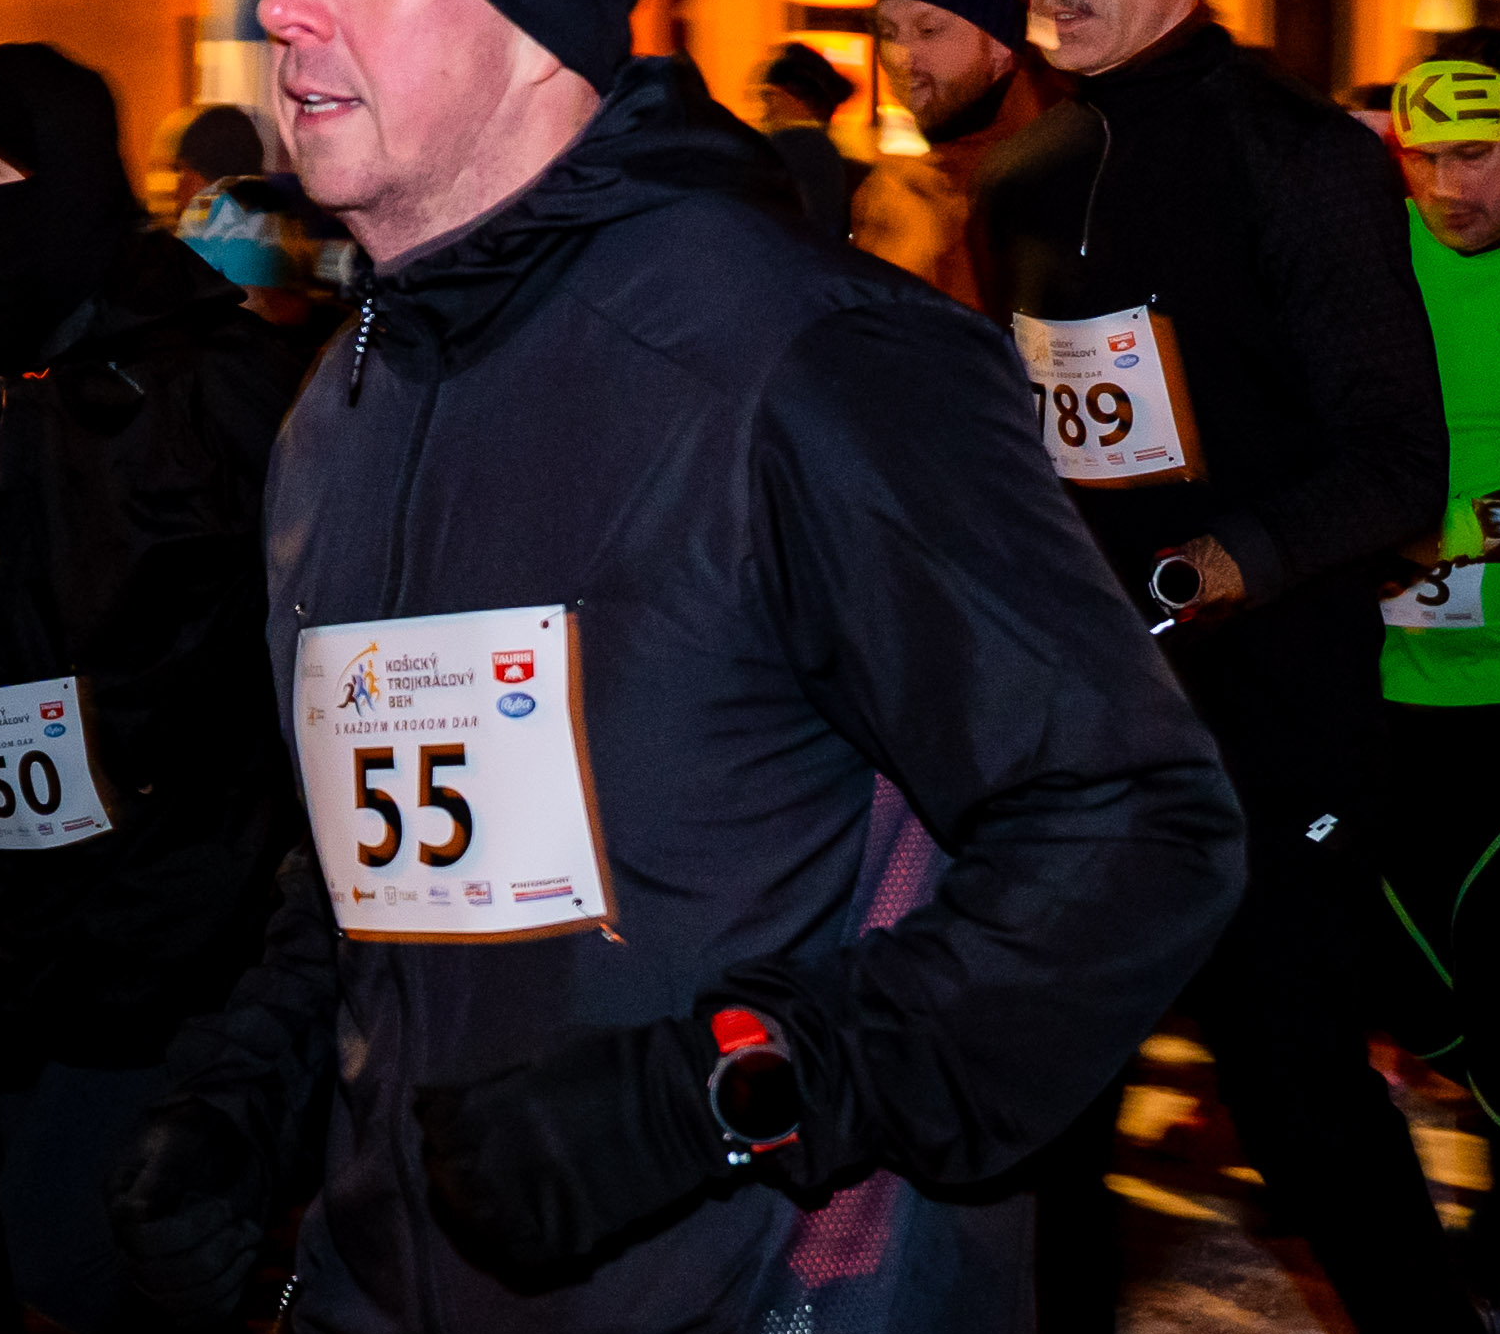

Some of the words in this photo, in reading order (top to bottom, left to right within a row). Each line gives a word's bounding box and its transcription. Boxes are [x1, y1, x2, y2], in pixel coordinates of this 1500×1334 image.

[385, 652, 438, 673] KOŠICKÝ
[494, 651, 532, 665] TAURIS
[388, 695, 414, 708] BEH
[343, 720, 389, 734] KAŽDÝM
[393, 719, 447, 733] KROKOM
[452, 716, 479, 729] DAR
[17, 738, 34, 746] DAR
[353, 742, 474, 869] 55
